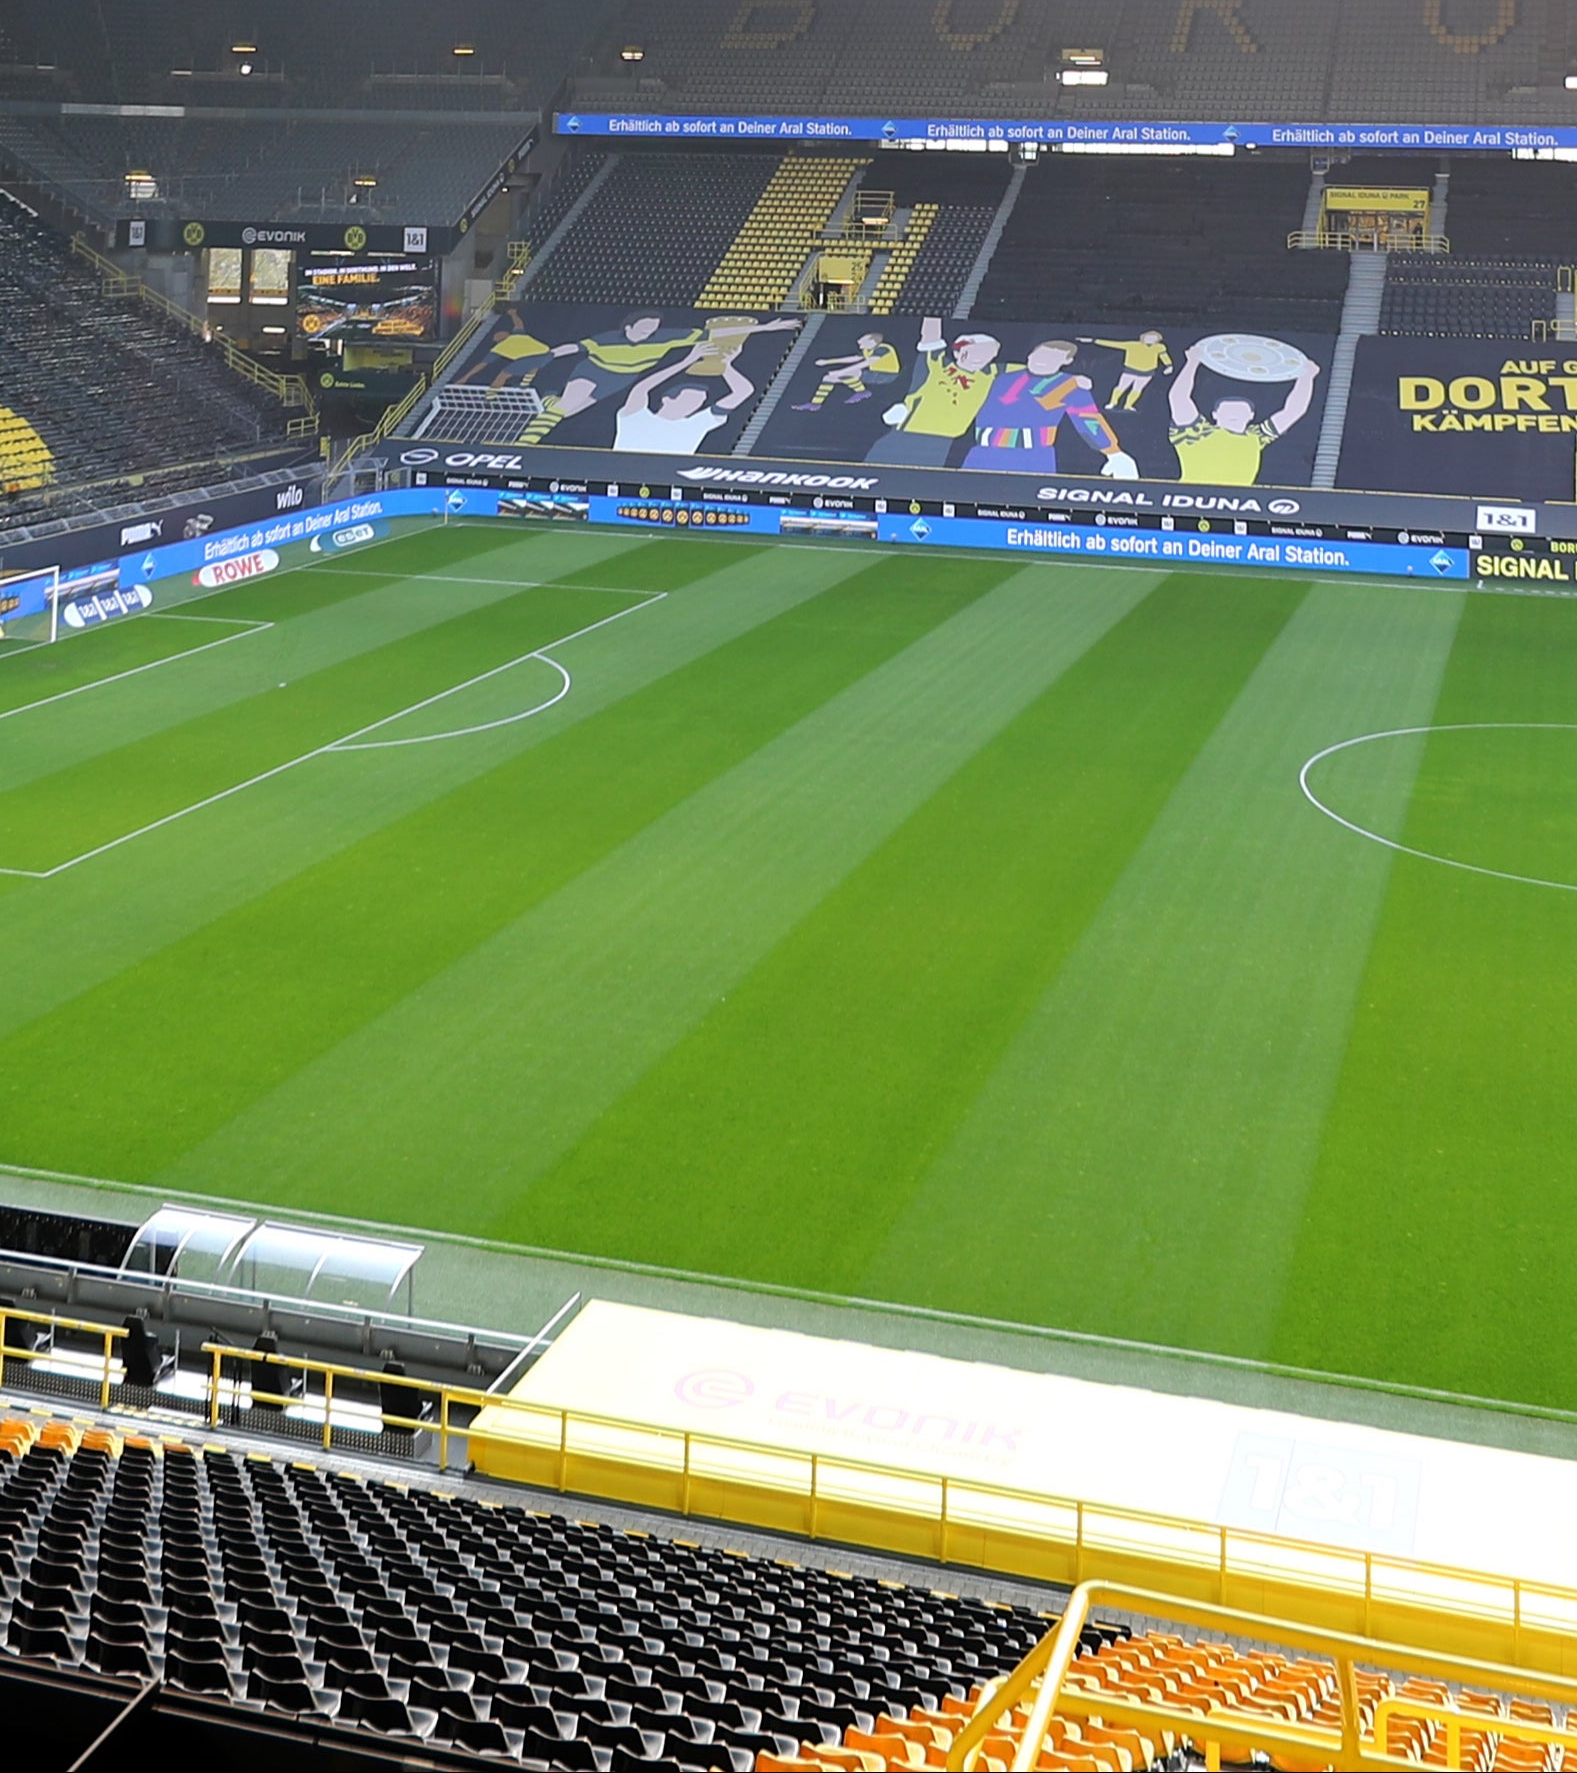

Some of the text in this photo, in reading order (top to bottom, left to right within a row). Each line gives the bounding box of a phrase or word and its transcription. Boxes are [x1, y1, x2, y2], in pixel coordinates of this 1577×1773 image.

[609, 119, 852, 136] Erhältlich ab sofort an Deiner Aral Station.
[927, 124, 1191, 141] Erhältlich ab sofort an Deiner Aral Station.
[1272, 128, 1558, 146] Erhältlich ab sofort an Deiner Aral Station.
[1413, 200, 1425, 208] 27
[257, 231, 306, 242] EVONIK
[407, 233, 424, 245] 1&1
[1500, 360, 1558, 375] AUF
[445, 452, 523, 470] OPEL
[277, 485, 303, 509] wilo
[1036, 487, 1262, 512] SIGNAL IDUNA
[1482, 512, 1529, 527] 1&1
[1006, 528, 1350, 566] Erhältlich ab sofort an Deiner Aral Station.
[214, 553, 264, 584] ROWE
[1476, 555, 1569, 580] SIGNAL
[774, 1389, 1024, 1452] EVONIK
[1244, 1454, 1398, 1530] 1&1
